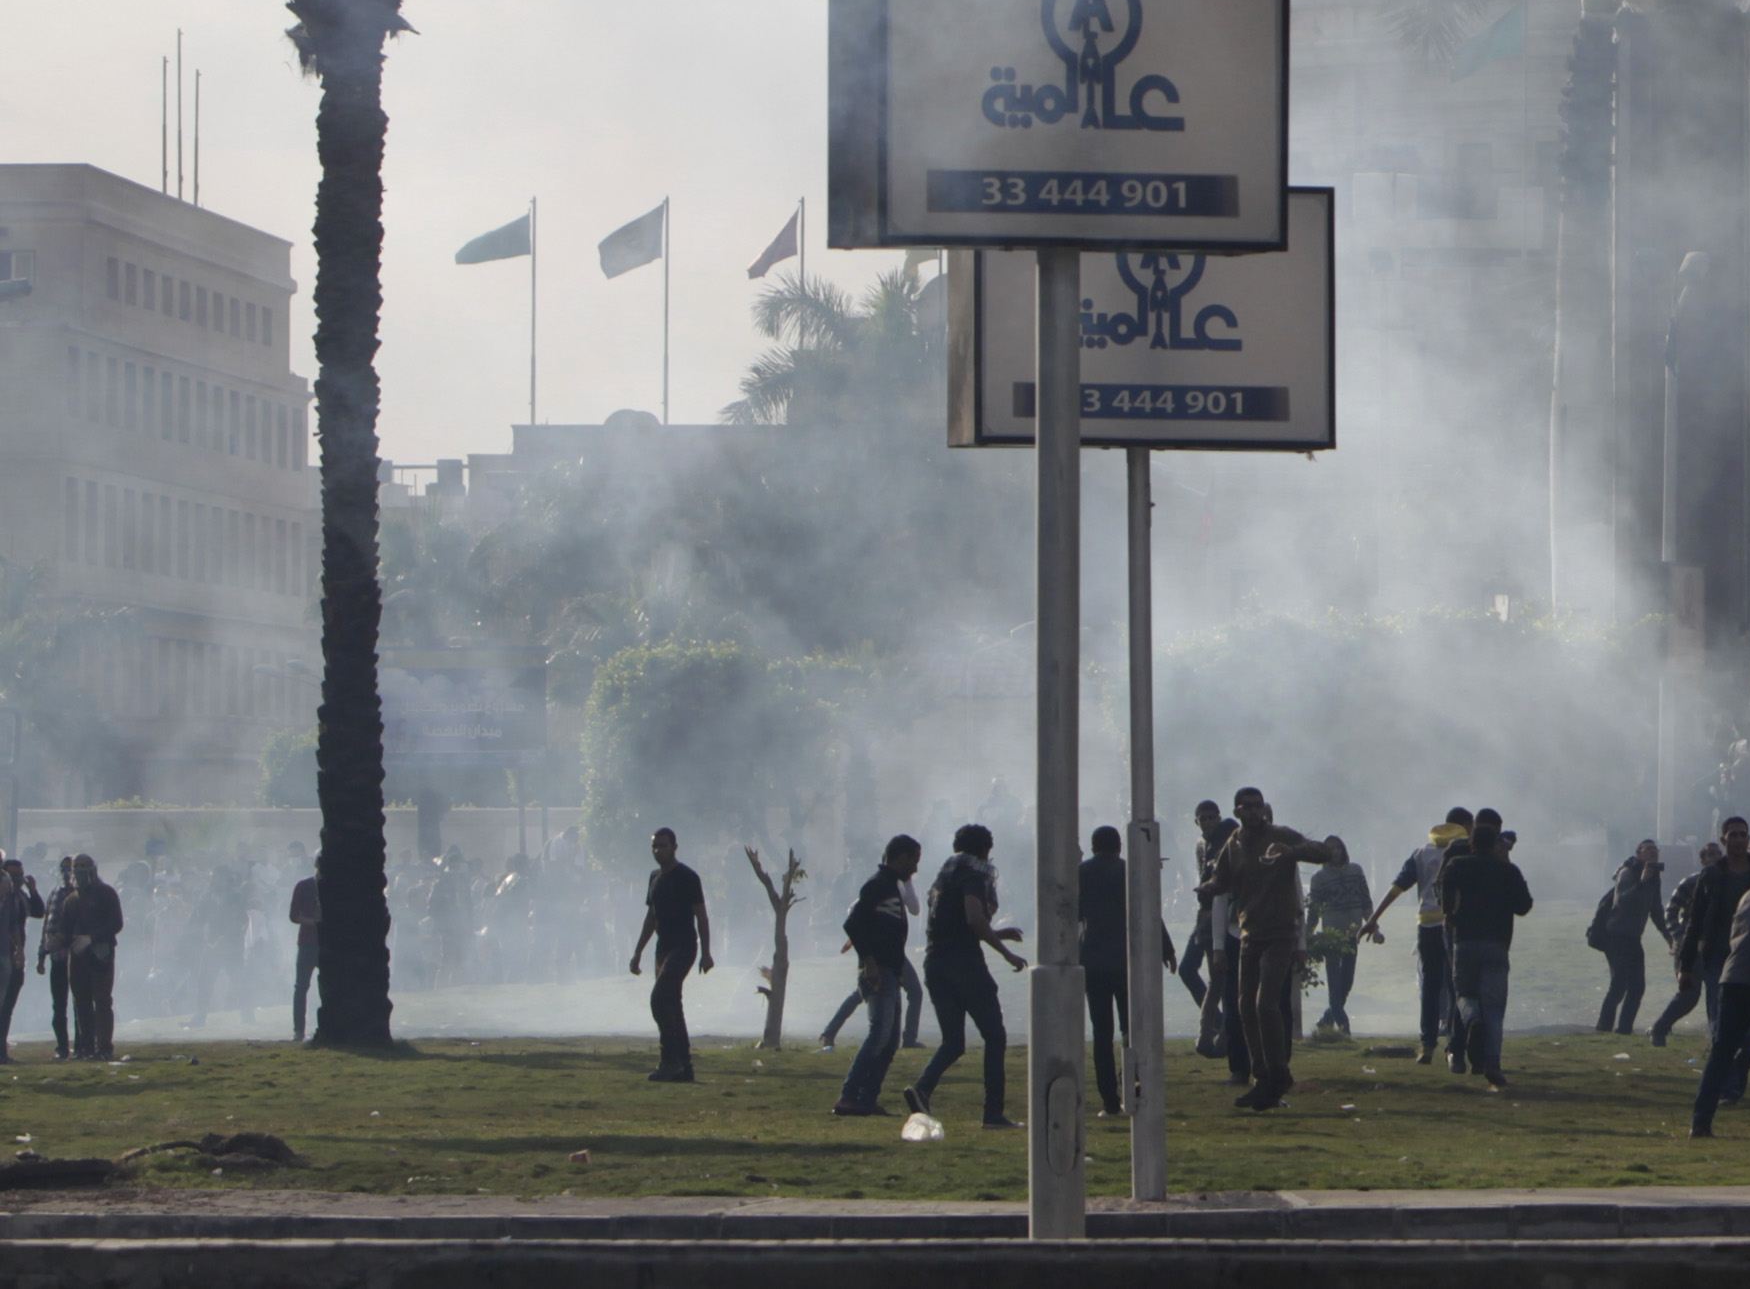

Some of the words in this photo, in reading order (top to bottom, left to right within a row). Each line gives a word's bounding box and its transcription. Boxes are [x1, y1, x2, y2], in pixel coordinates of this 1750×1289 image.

[982, 177, 1026, 206] 33
[1039, 178, 1110, 208] 444
[1121, 179, 1188, 209] 901
[1083, 389, 1101, 412] 3
[1112, 390, 1175, 413] 444
[1185, 391, 1243, 415] 901
